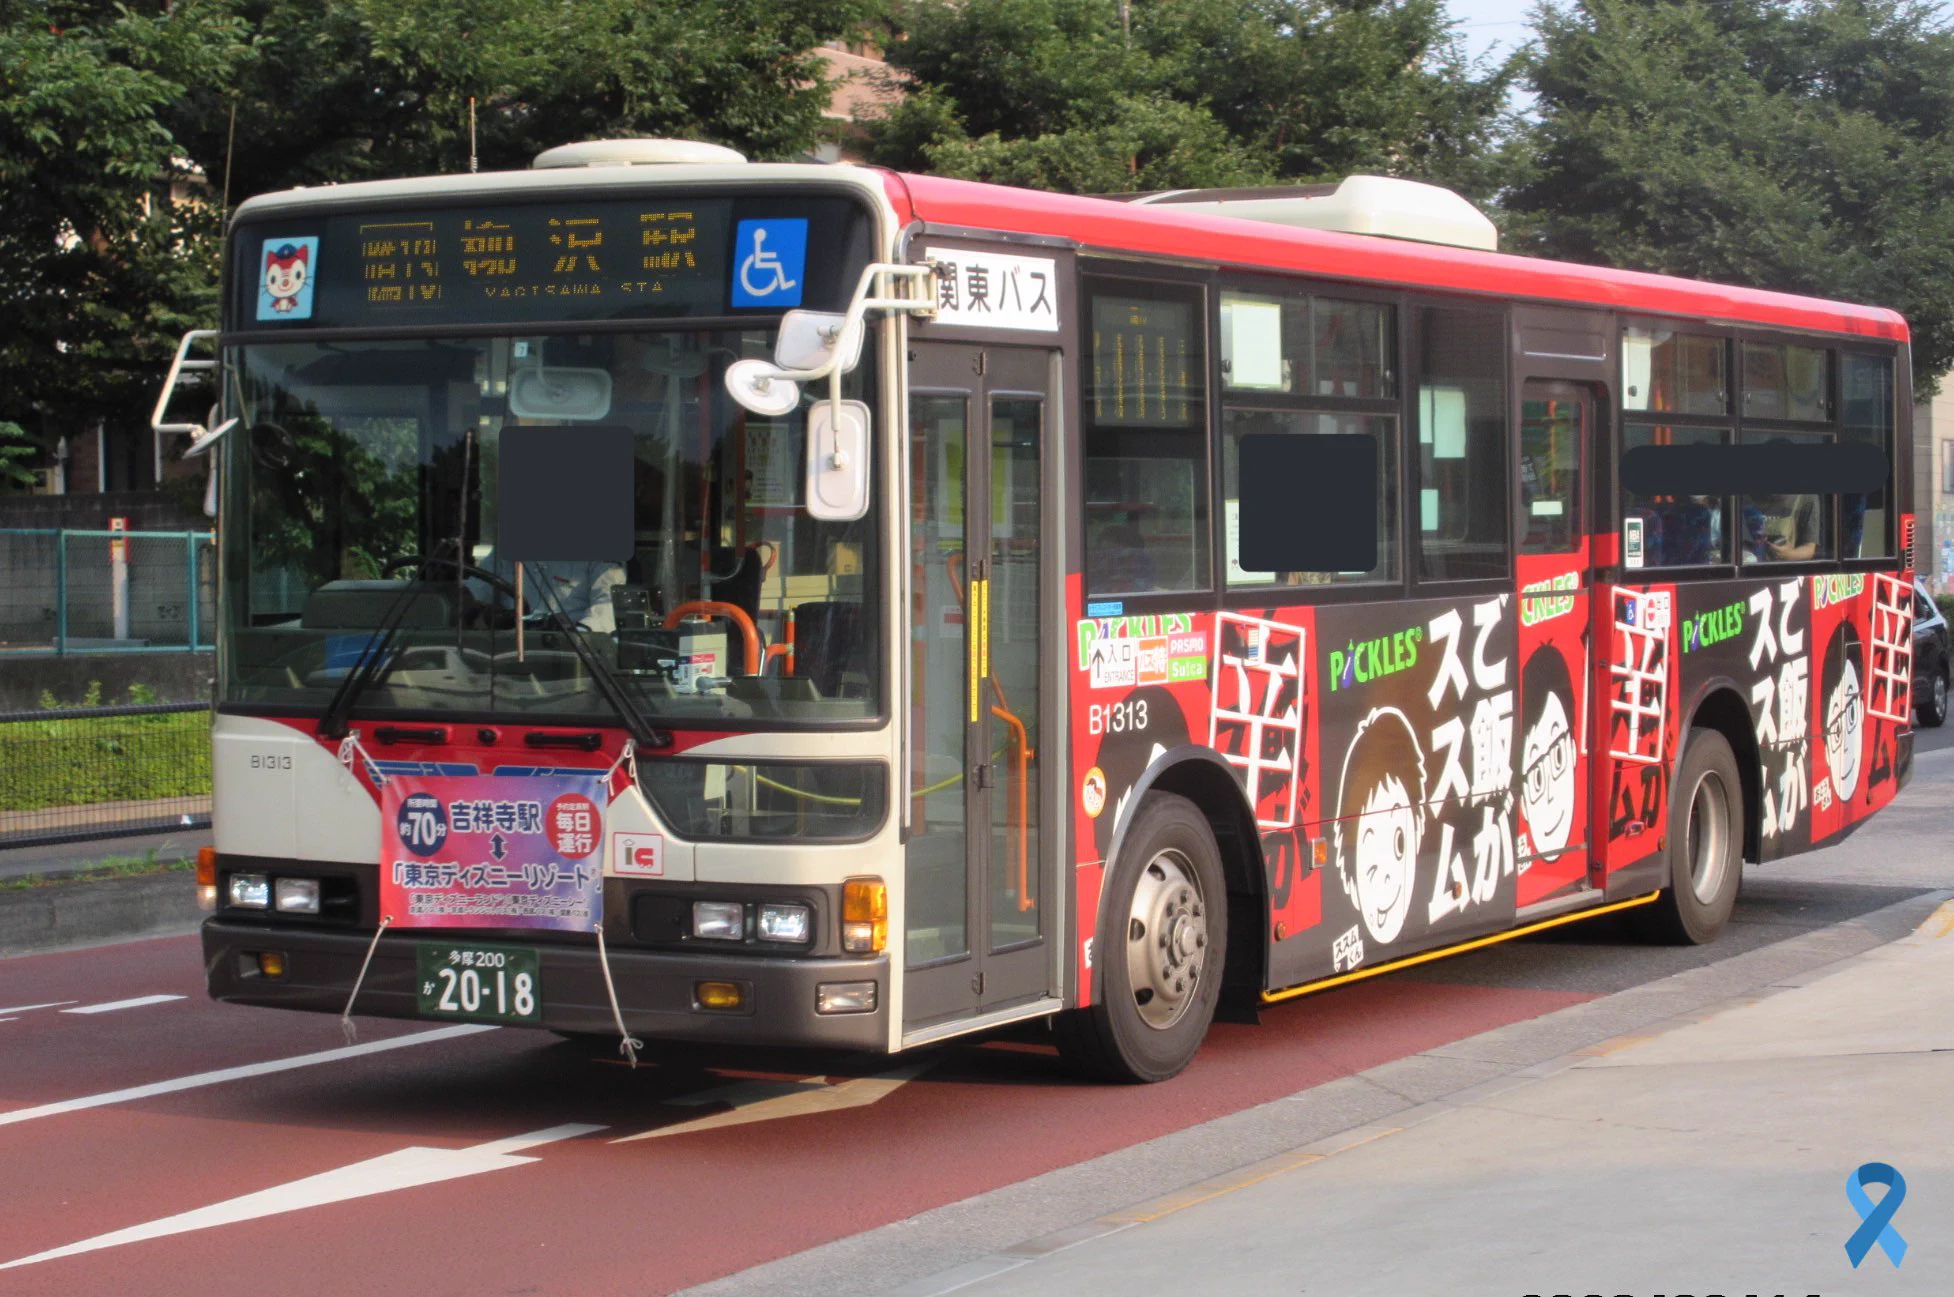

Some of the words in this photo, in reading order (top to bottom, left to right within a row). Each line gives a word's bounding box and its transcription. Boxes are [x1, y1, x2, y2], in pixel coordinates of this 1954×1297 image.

[936, 260, 1052, 315] 関東バス
[1108, 643, 1131, 663] 入口
[1170, 637, 1204, 655] PASMO
[1171, 660, 1203, 678] Suica
[1089, 699, 1148, 736] B1313
[450, 801, 544, 834] 吉祥寺駅
[555, 811, 593, 833] 毎日
[556, 833, 593, 853] 運行
[438, 968, 535, 1016] 20-18
